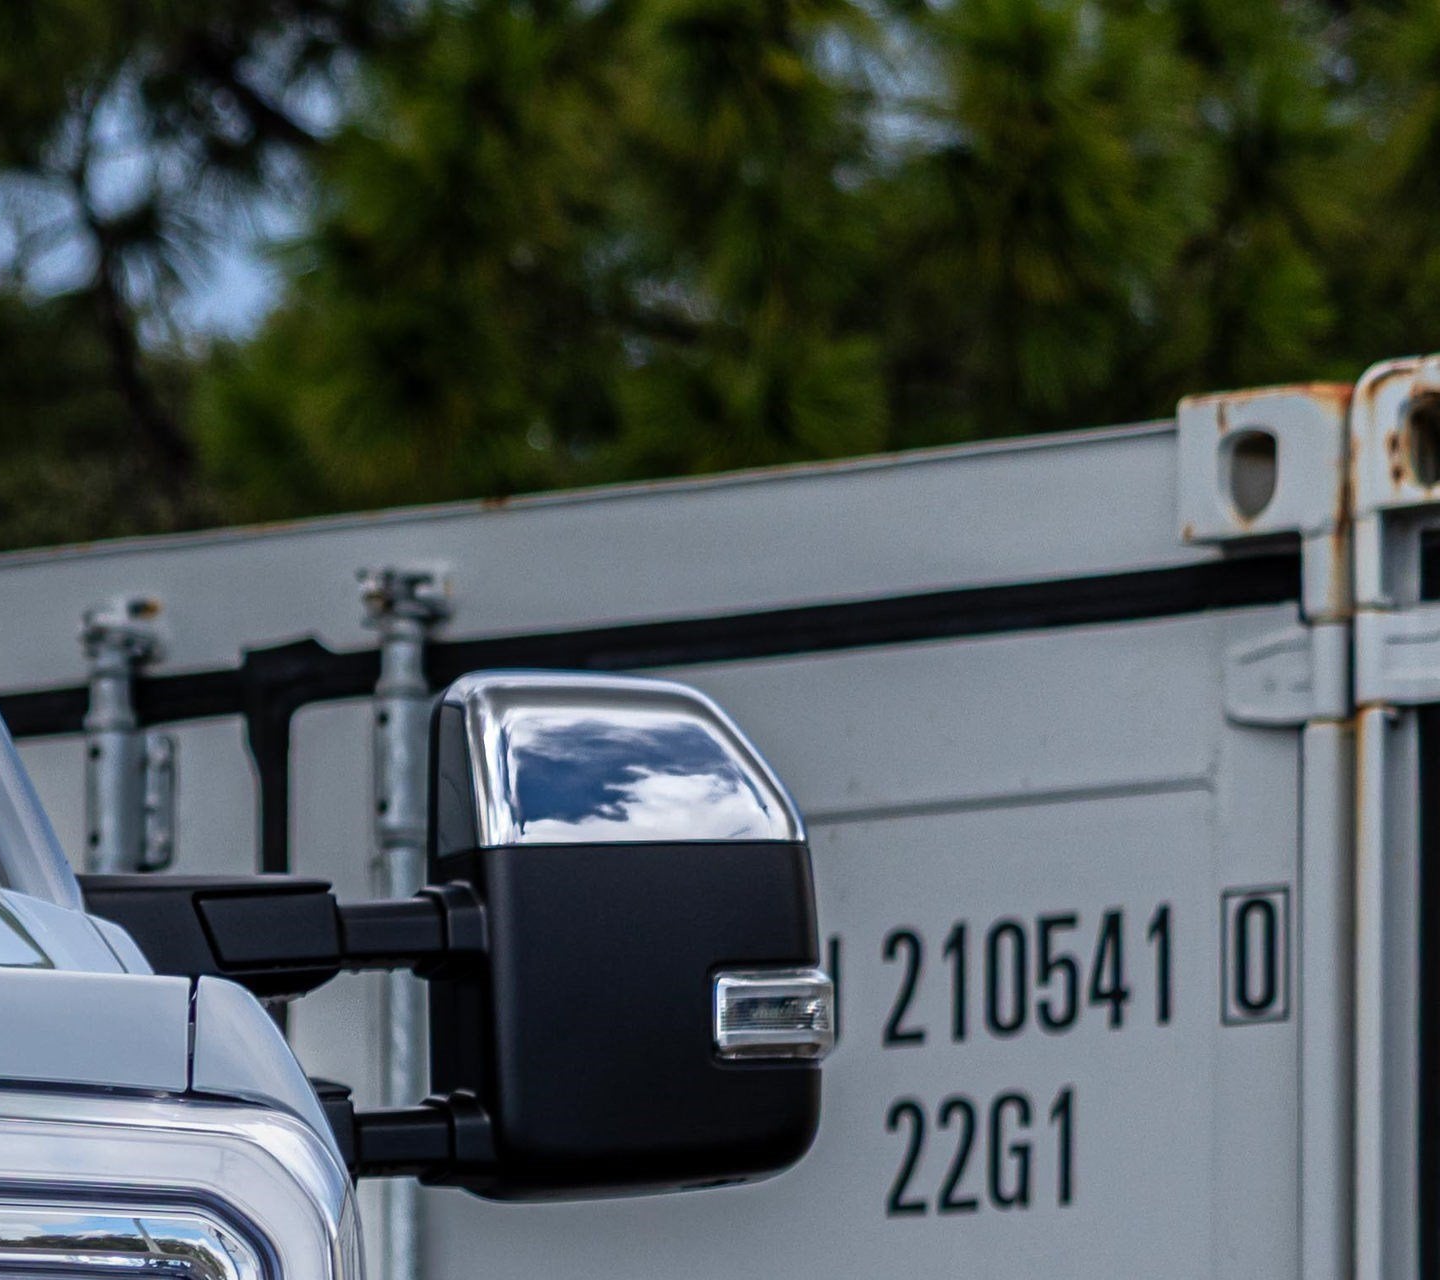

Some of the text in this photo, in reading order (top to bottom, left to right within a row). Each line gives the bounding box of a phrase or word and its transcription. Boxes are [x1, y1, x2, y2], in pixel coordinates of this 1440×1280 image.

[883, 903, 1172, 1047] 210541
[1233, 896, 1278, 1011] 0
[885, 1084, 1076, 1217] 22G1
